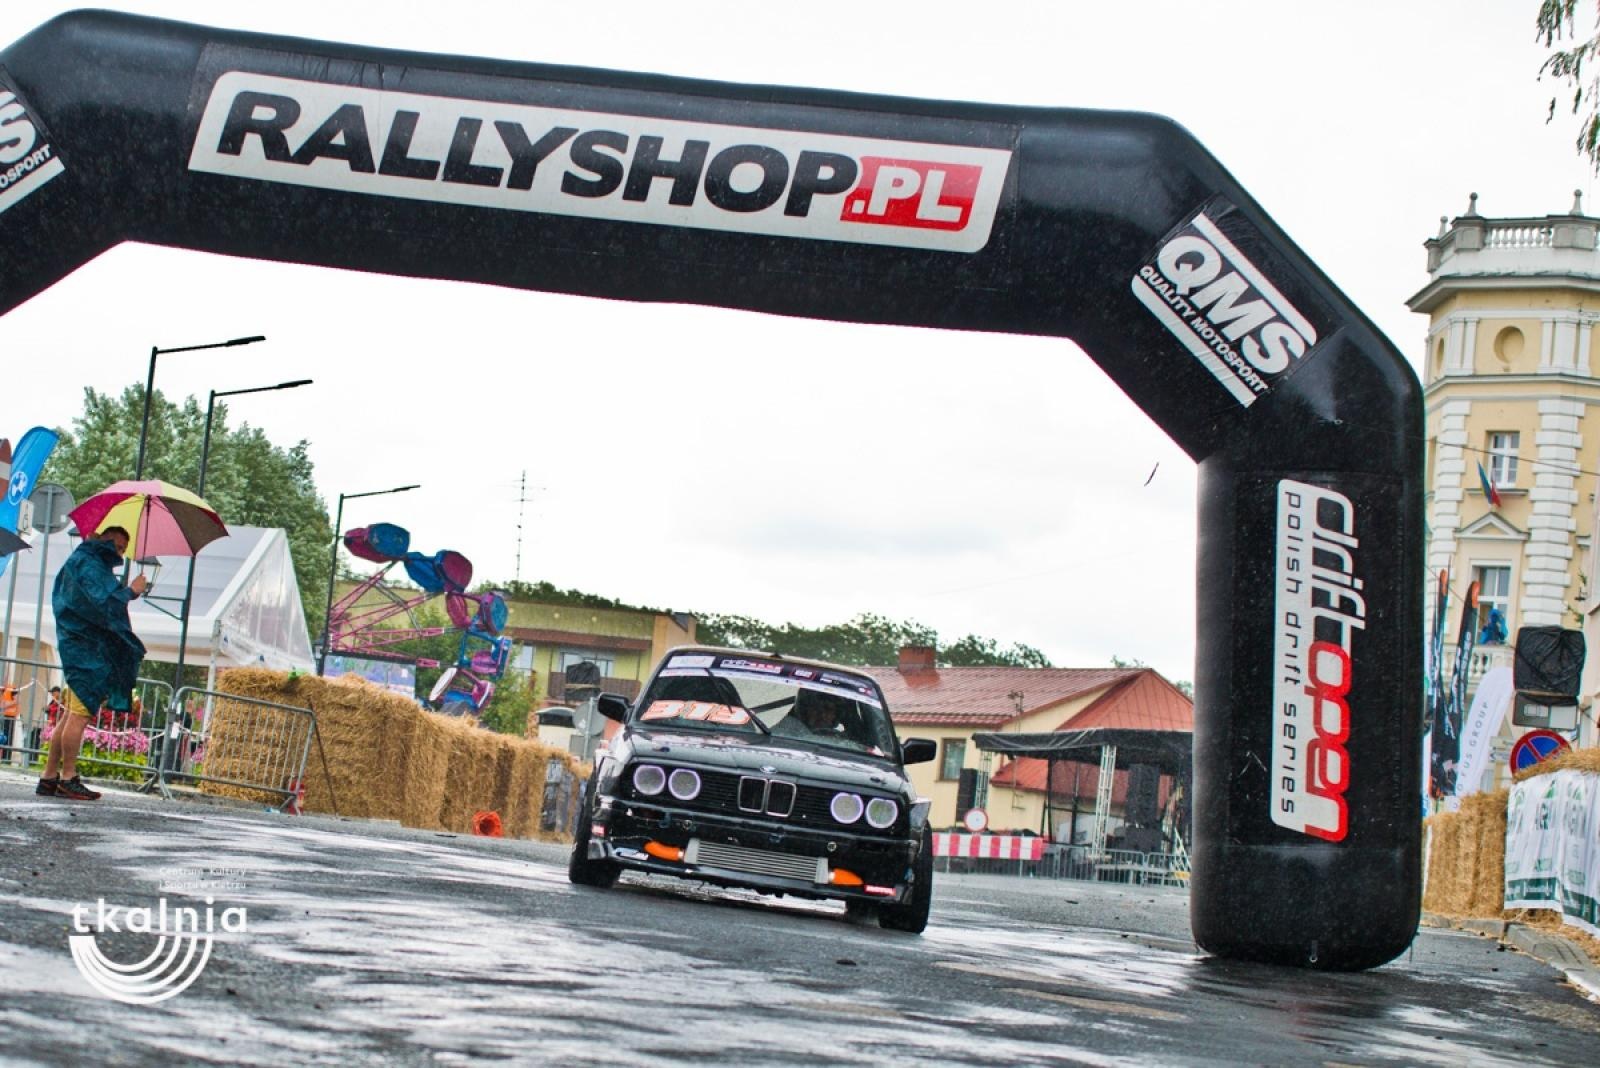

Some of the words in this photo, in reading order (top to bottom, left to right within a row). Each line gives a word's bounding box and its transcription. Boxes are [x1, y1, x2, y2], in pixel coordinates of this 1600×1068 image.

[217, 90, 964, 223] RALLYSHOP.PL
[1139, 264, 1197, 317] QUALITY
[1190, 316, 1269, 393] MOTOSPORT
[1157, 235, 1305, 374] QMS
[1285, 491, 1304, 594] polish
[1284, 611, 1302, 685] drift
[1281, 702, 1297, 813] series
[1469, 702, 1488, 747] GROUP
